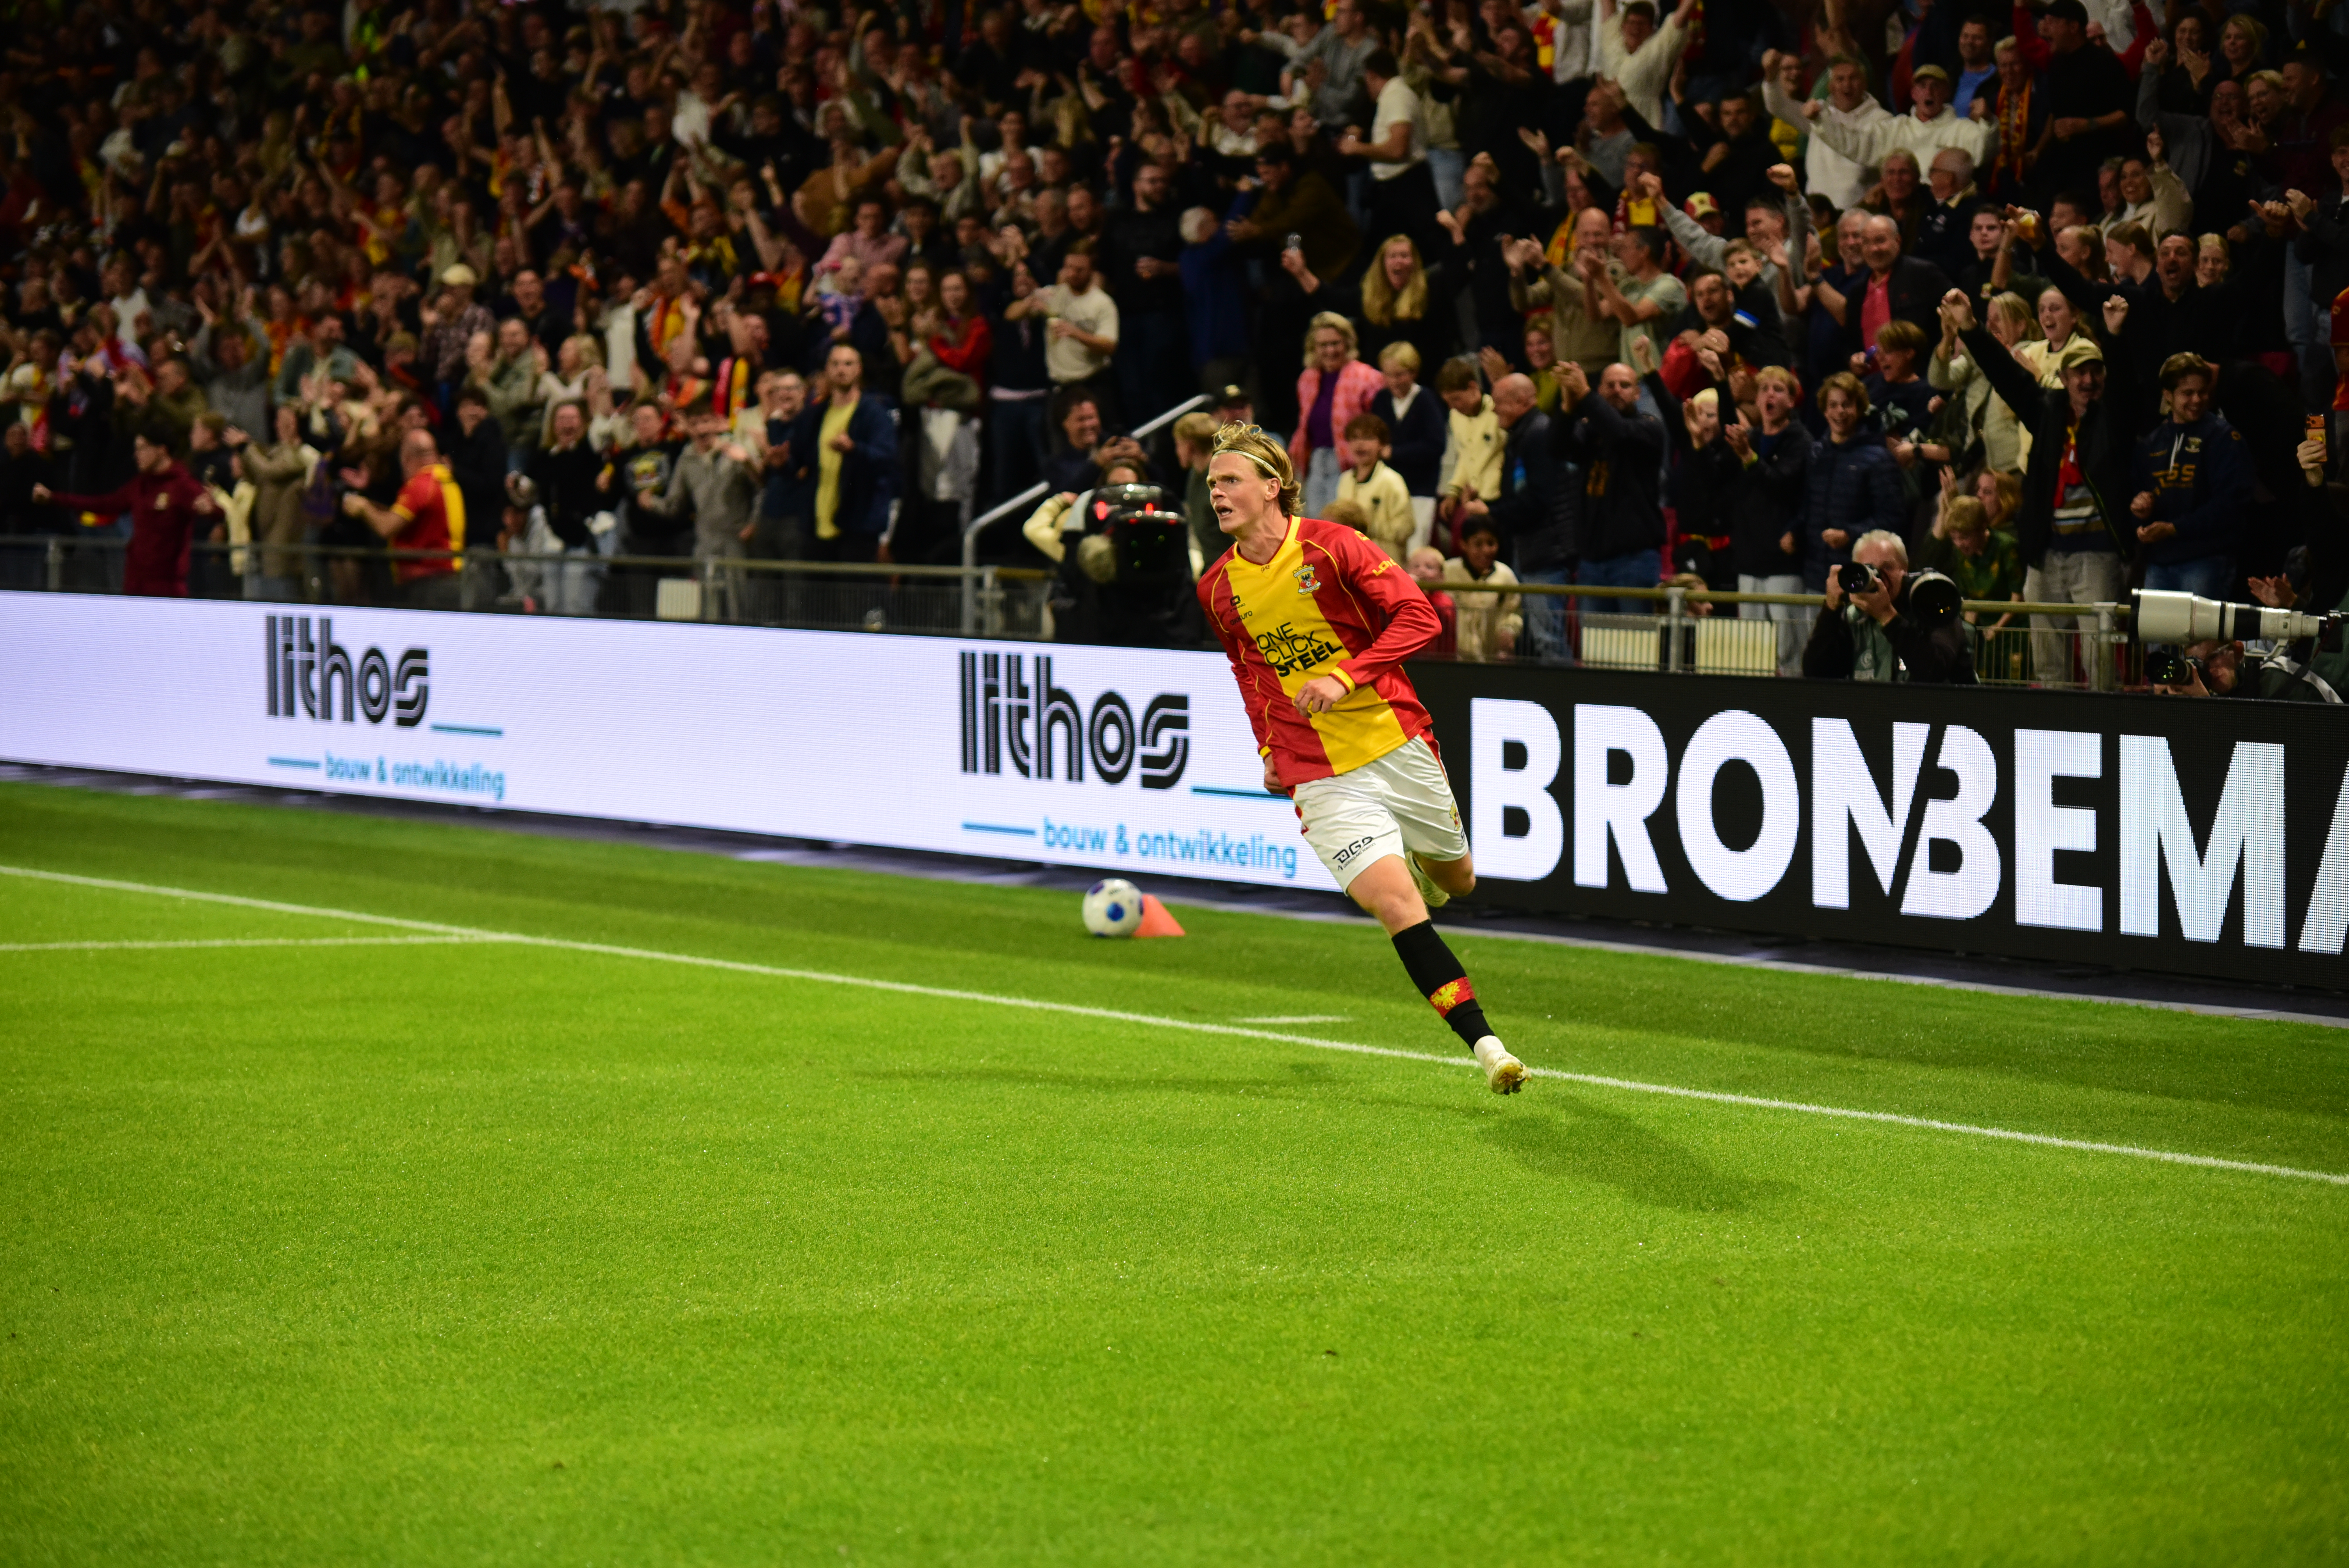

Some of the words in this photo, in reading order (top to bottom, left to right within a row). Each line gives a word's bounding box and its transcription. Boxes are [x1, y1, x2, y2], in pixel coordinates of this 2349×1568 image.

[1256, 622, 1297, 649] ONE
[1264, 631, 1322, 665] CLICK
[1275, 641, 1343, 677] STEEL
[267, 615, 428, 727] lithos
[961, 651, 1189, 789] lithos
[325, 750, 371, 780] bouw
[392, 759, 505, 801] ontwikkeling
[1044, 817, 1107, 850] bouw
[1115, 823, 1129, 854] &
[1137, 829, 1297, 878] ontwikkeling
